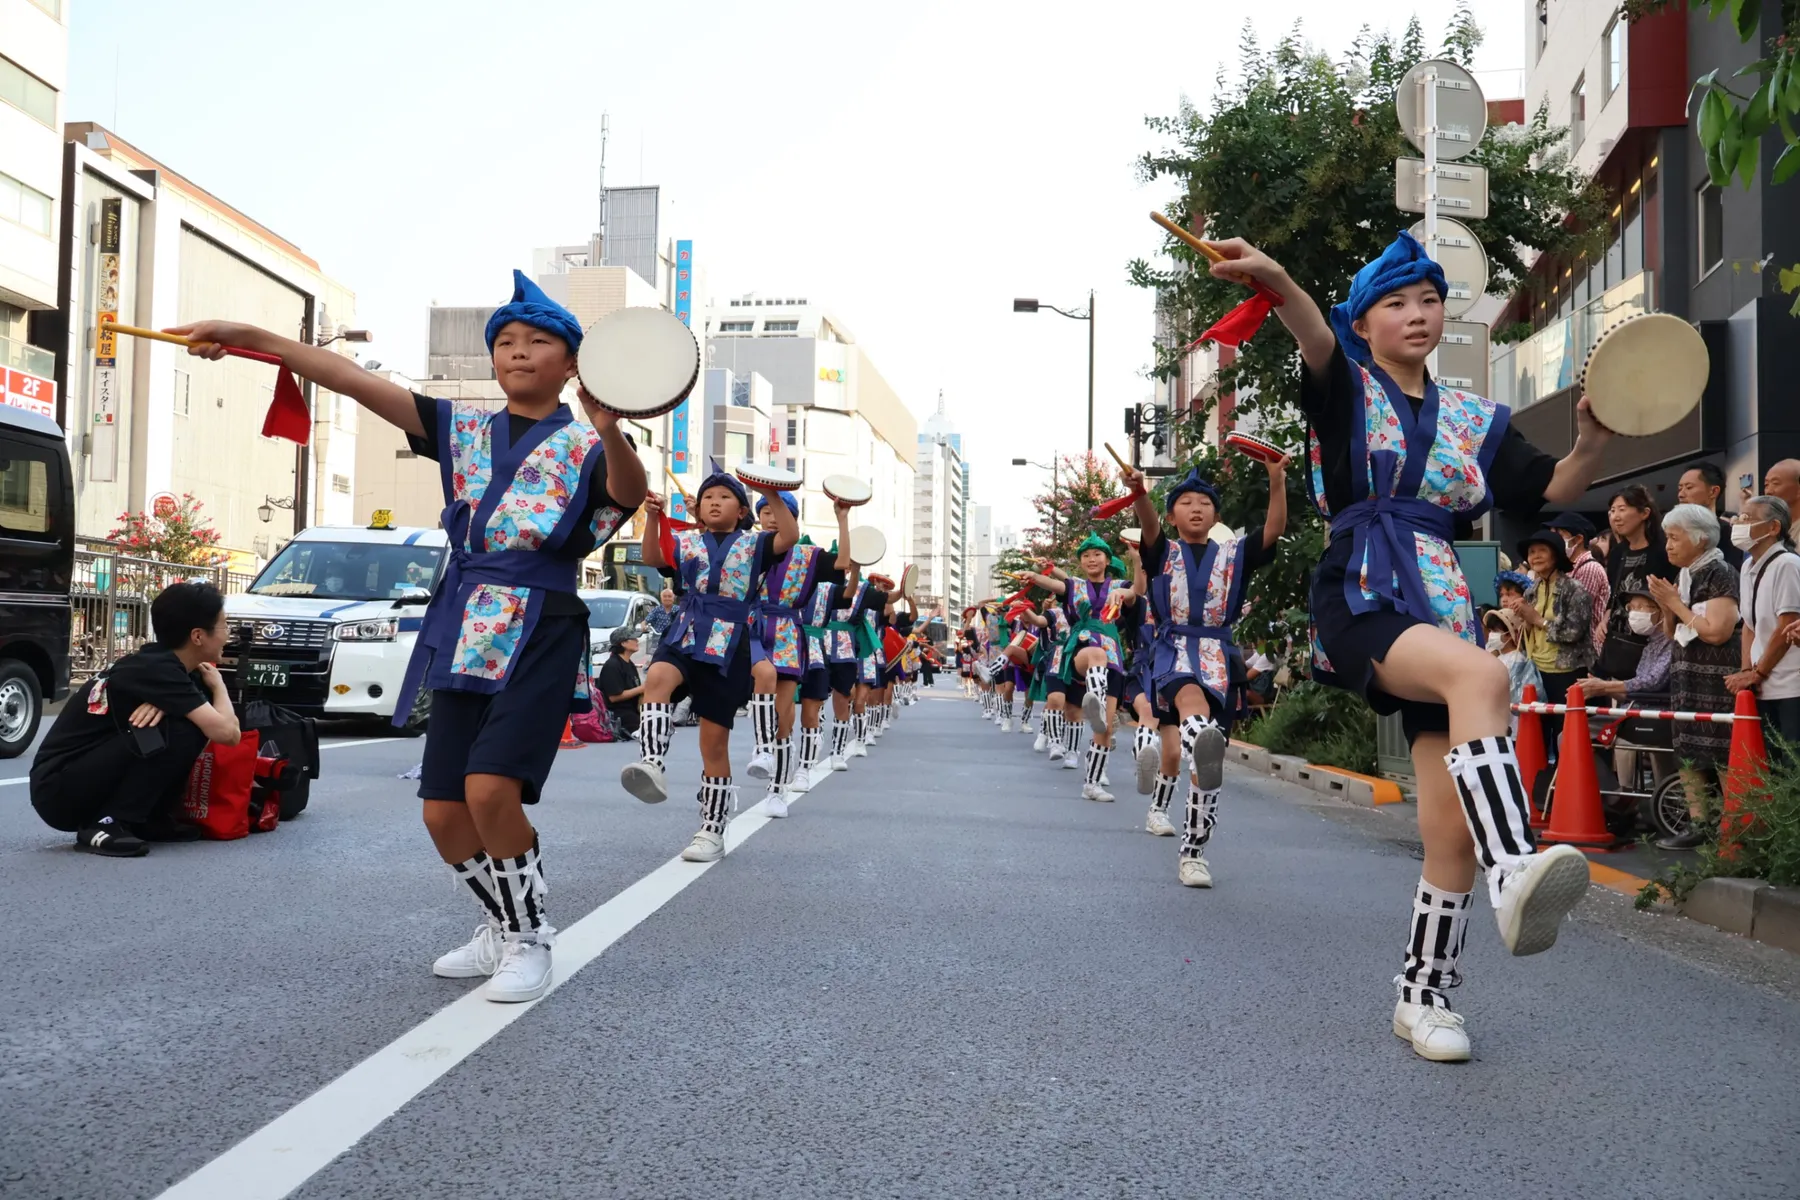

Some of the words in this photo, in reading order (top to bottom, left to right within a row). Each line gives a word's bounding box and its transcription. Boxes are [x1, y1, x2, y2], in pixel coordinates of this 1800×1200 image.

[679, 250, 689, 321] カラオケ
[22, 377, 41, 397] 2F
[100, 370, 111, 412] オイスター
[199, 752, 214, 810] KINOKUNIYA
